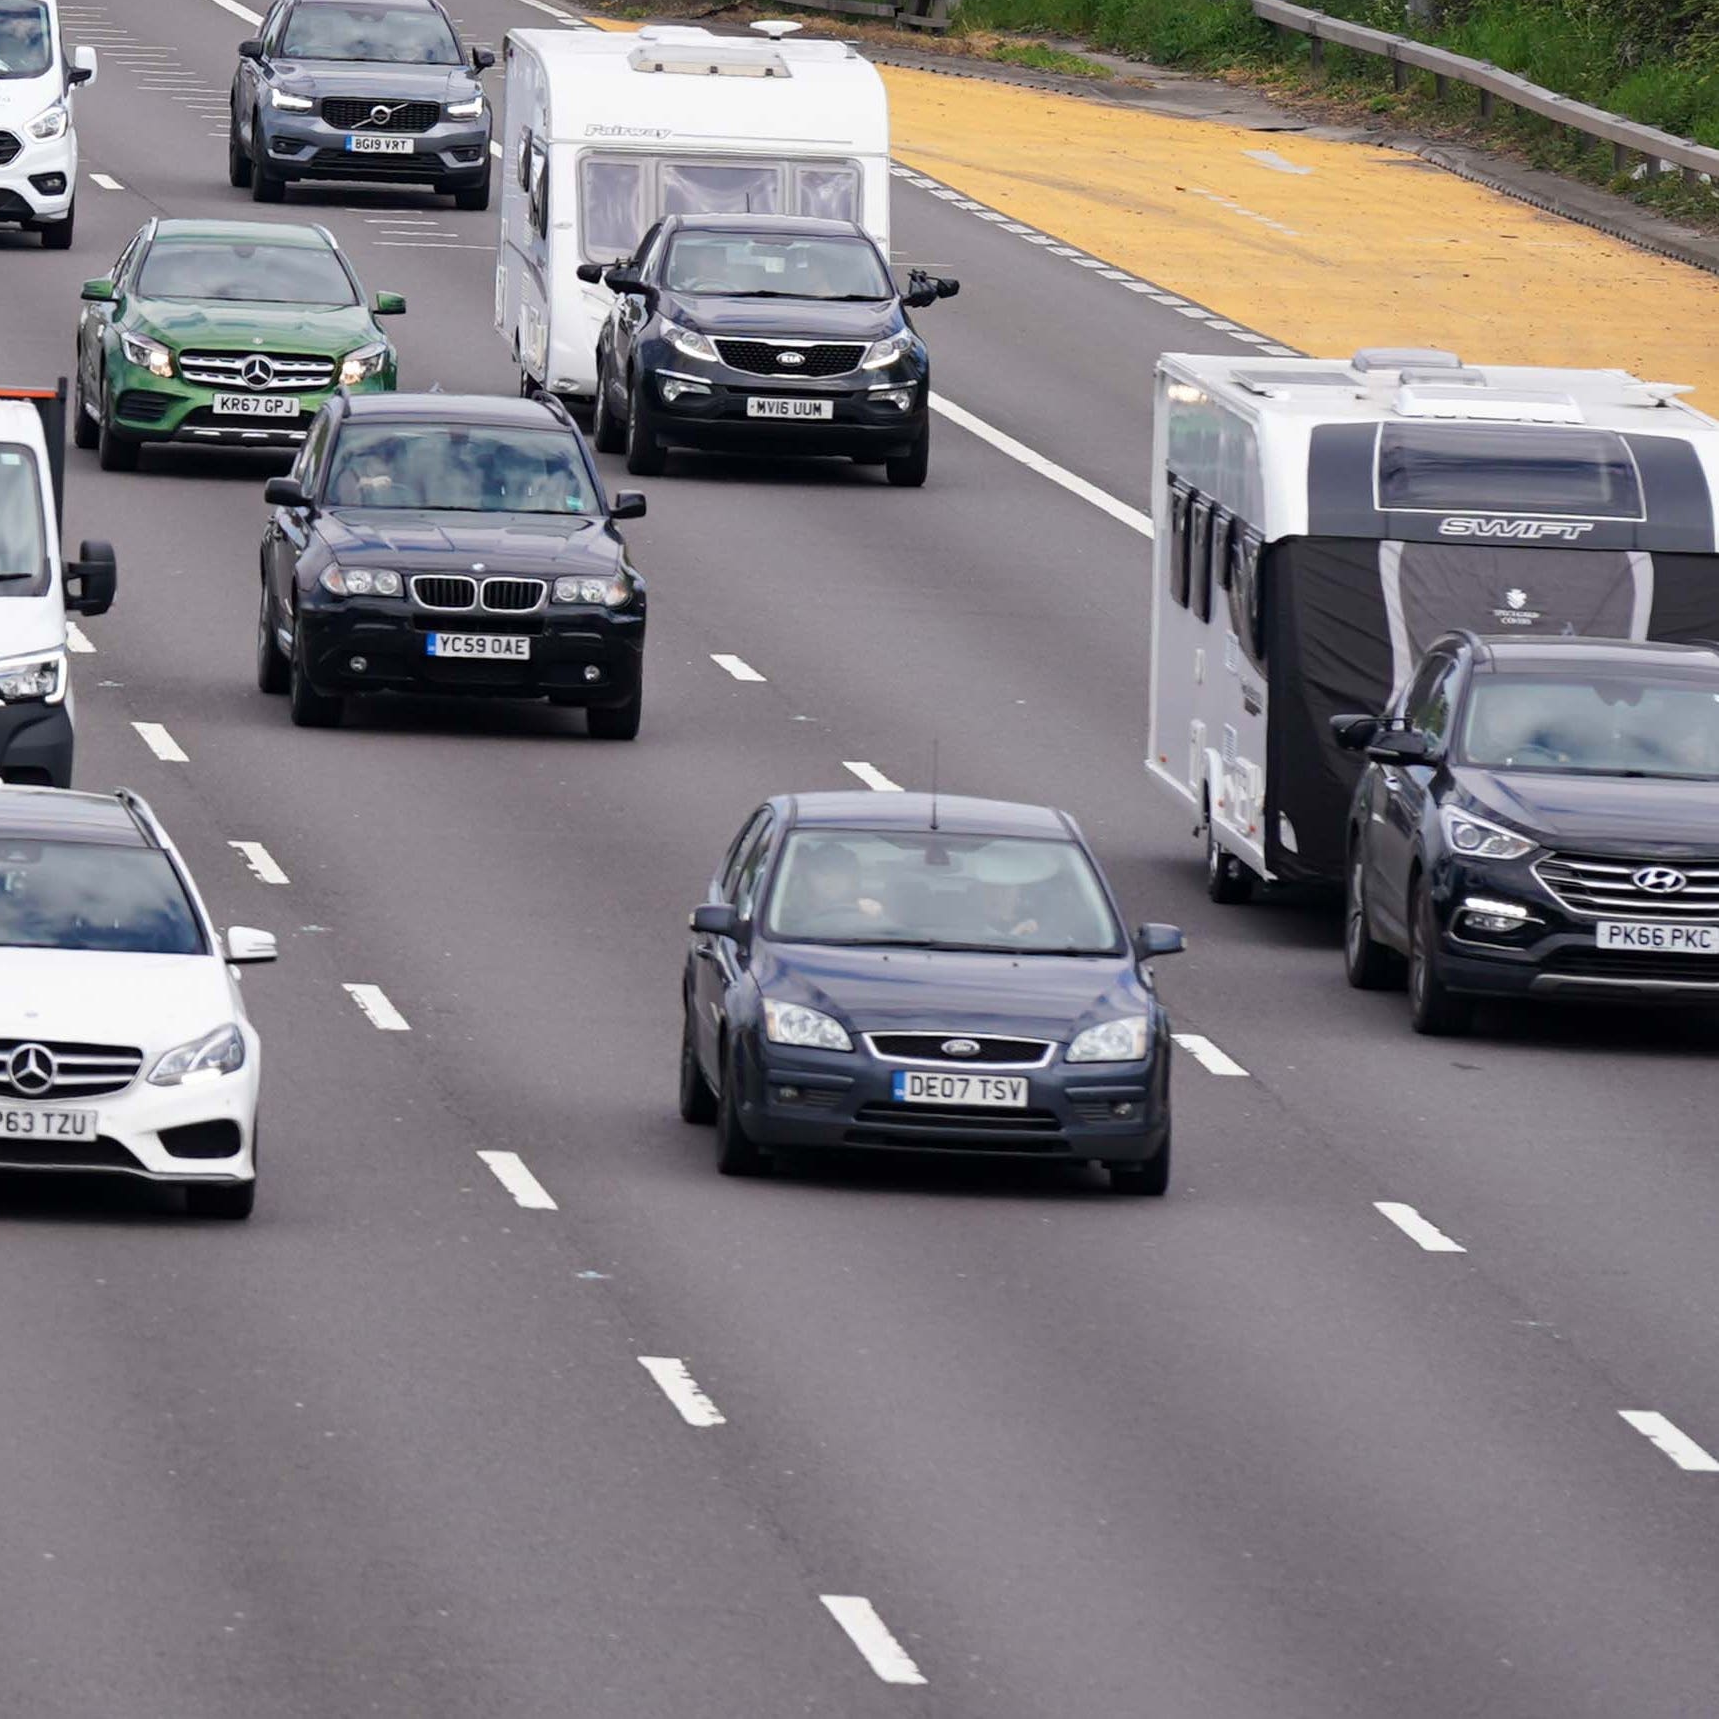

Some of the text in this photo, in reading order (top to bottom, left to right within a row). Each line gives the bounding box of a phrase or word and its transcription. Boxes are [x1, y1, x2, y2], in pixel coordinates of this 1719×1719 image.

[584, 123, 672, 140] Fairway
[384, 139, 407, 151] VRT
[220, 397, 294, 414] KR67 GPJ
[756, 401, 822, 416] MV16 UUM
[1437, 516, 1594, 540] SWIFT
[440, 636, 525, 656] YC59 OAE
[1608, 924, 1712, 949] PK66 PKC
[910, 1075, 1024, 1102] DE07 TSV
[43, 1114, 87, 1135] TZU
